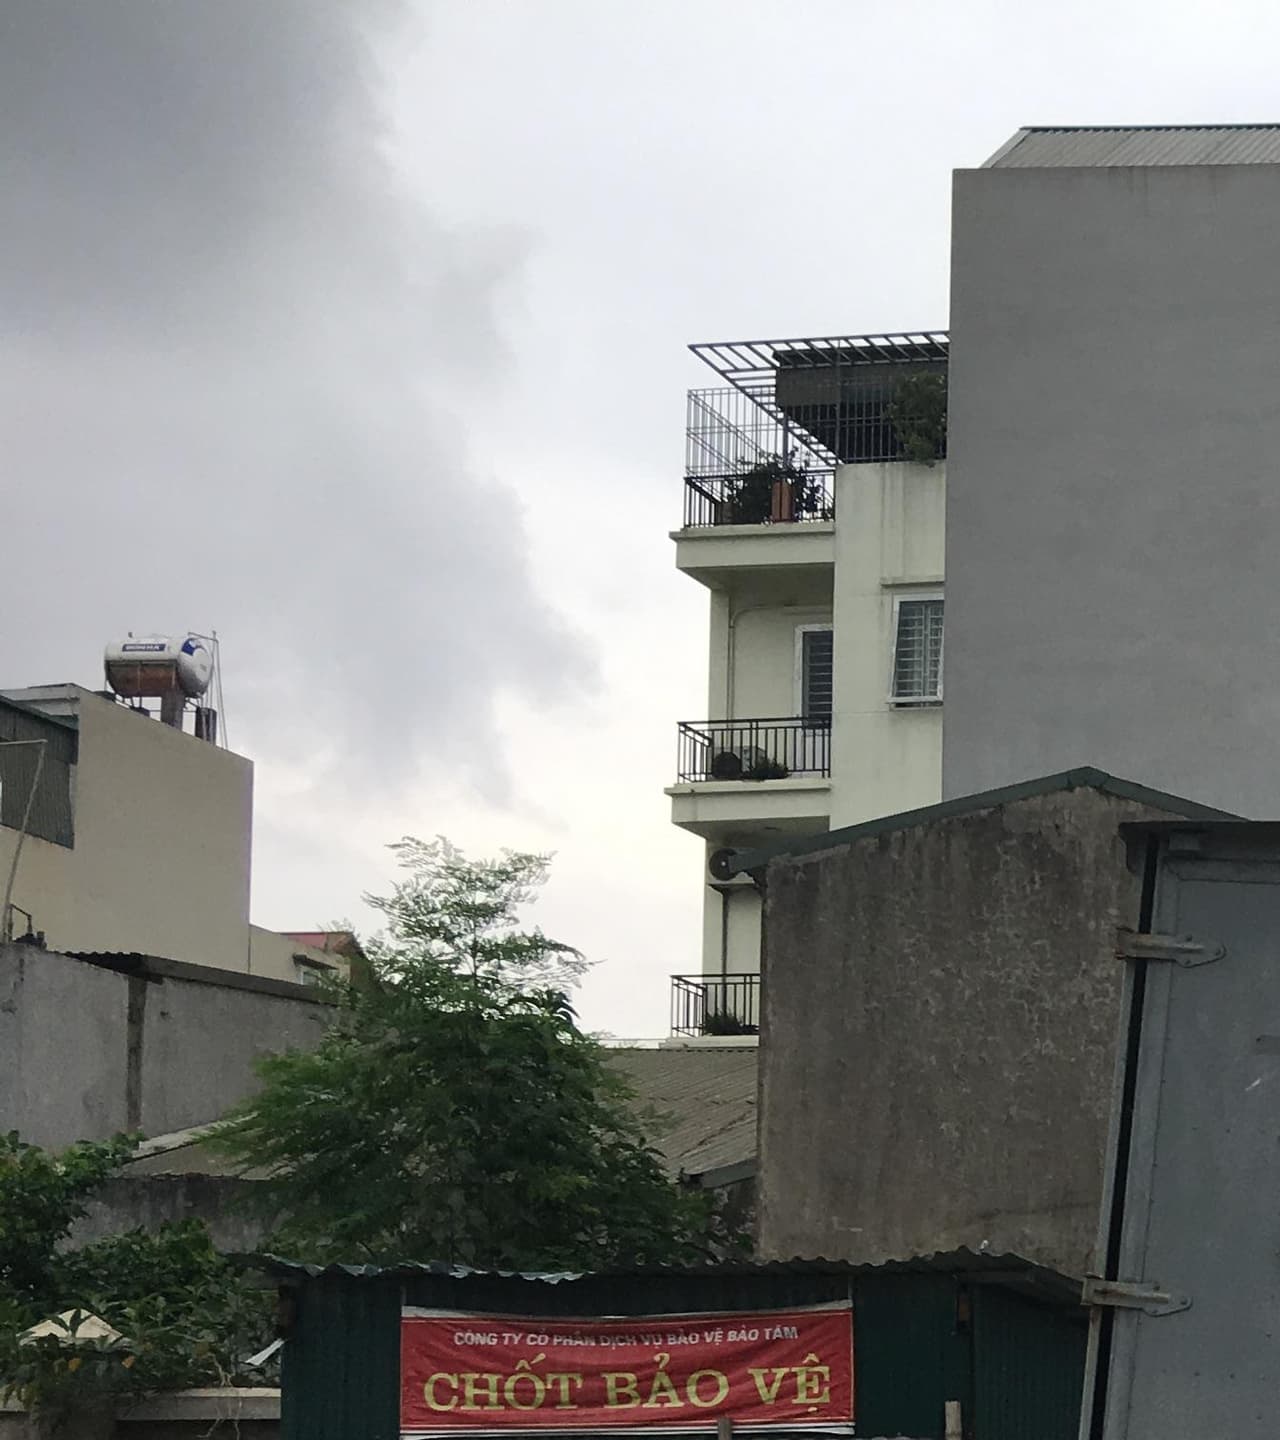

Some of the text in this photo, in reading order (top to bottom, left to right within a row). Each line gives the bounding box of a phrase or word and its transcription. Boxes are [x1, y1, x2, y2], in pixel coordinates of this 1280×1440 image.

[453, 1328, 499, 1346] CÔNG
[501, 1331, 523, 1346] TY
[703, 1327, 724, 1346] VỆ
[423, 1352, 831, 1413] CHỐT BẢO VỆ
